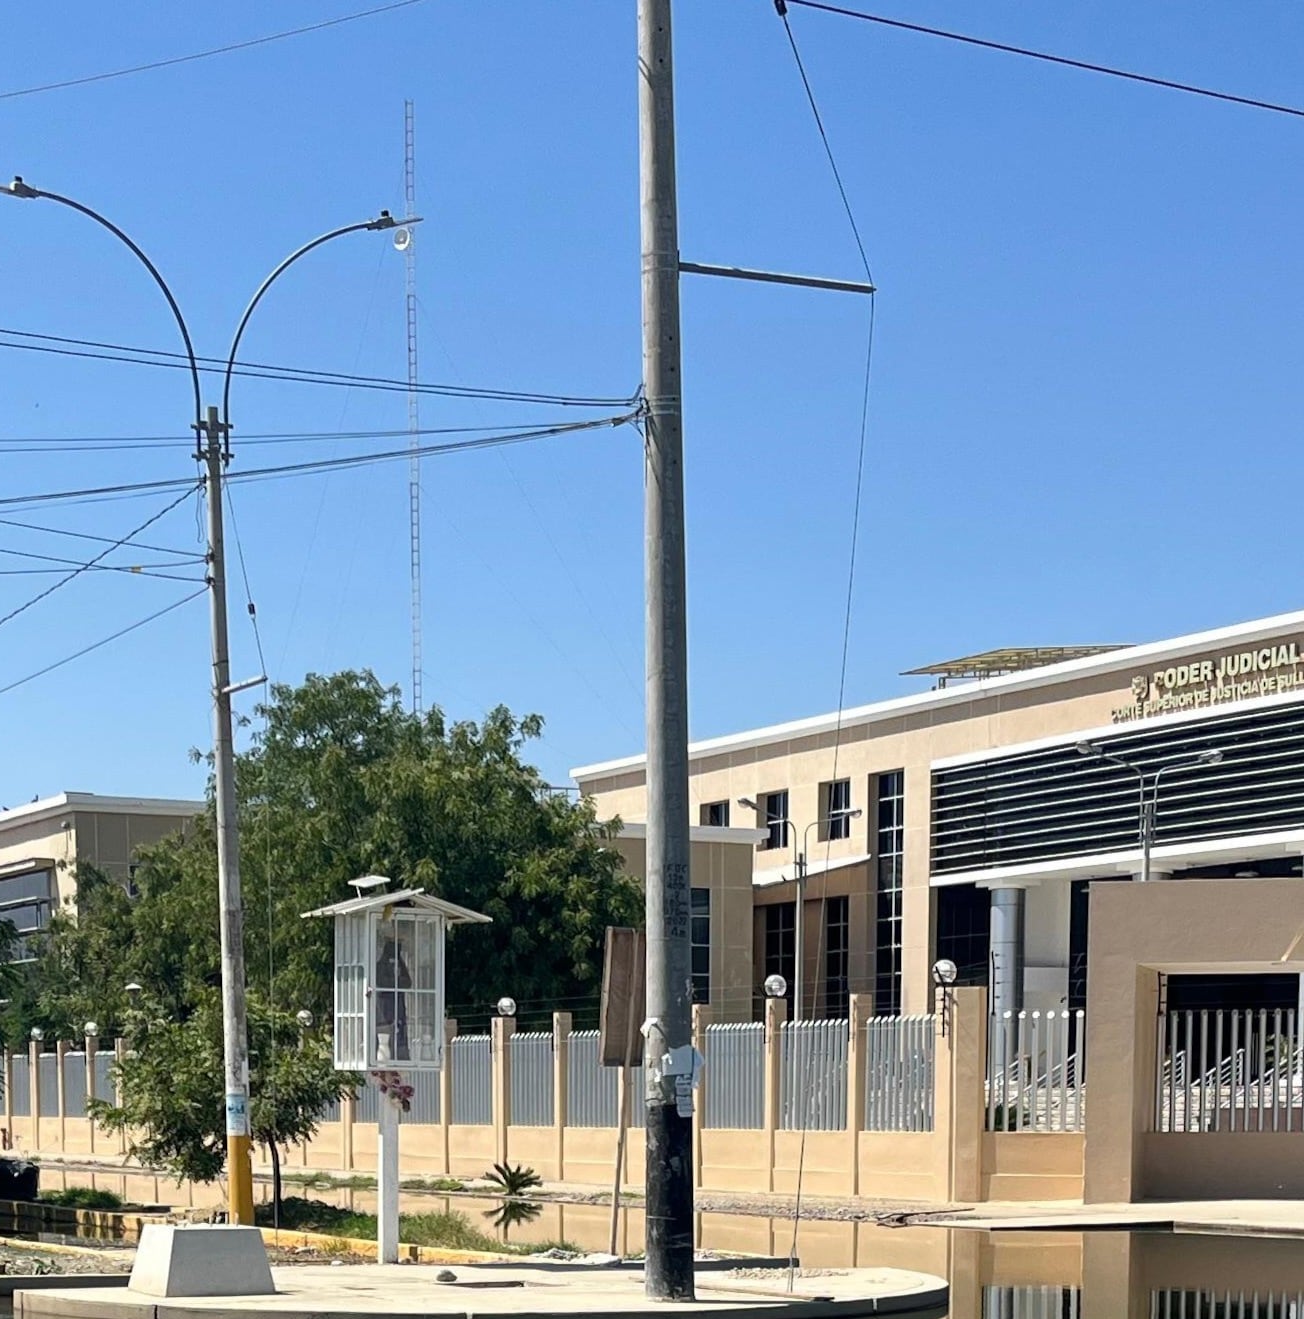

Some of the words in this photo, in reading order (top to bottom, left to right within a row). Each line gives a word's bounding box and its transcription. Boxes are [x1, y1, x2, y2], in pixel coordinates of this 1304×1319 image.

[1215, 643, 1301, 677] JUDICIAL
[1143, 692, 1194, 714] SUPERIOR
[1196, 689, 1210, 704] DE
[1211, 681, 1259, 701] JUSTICIA
[1261, 678, 1276, 692] DE
